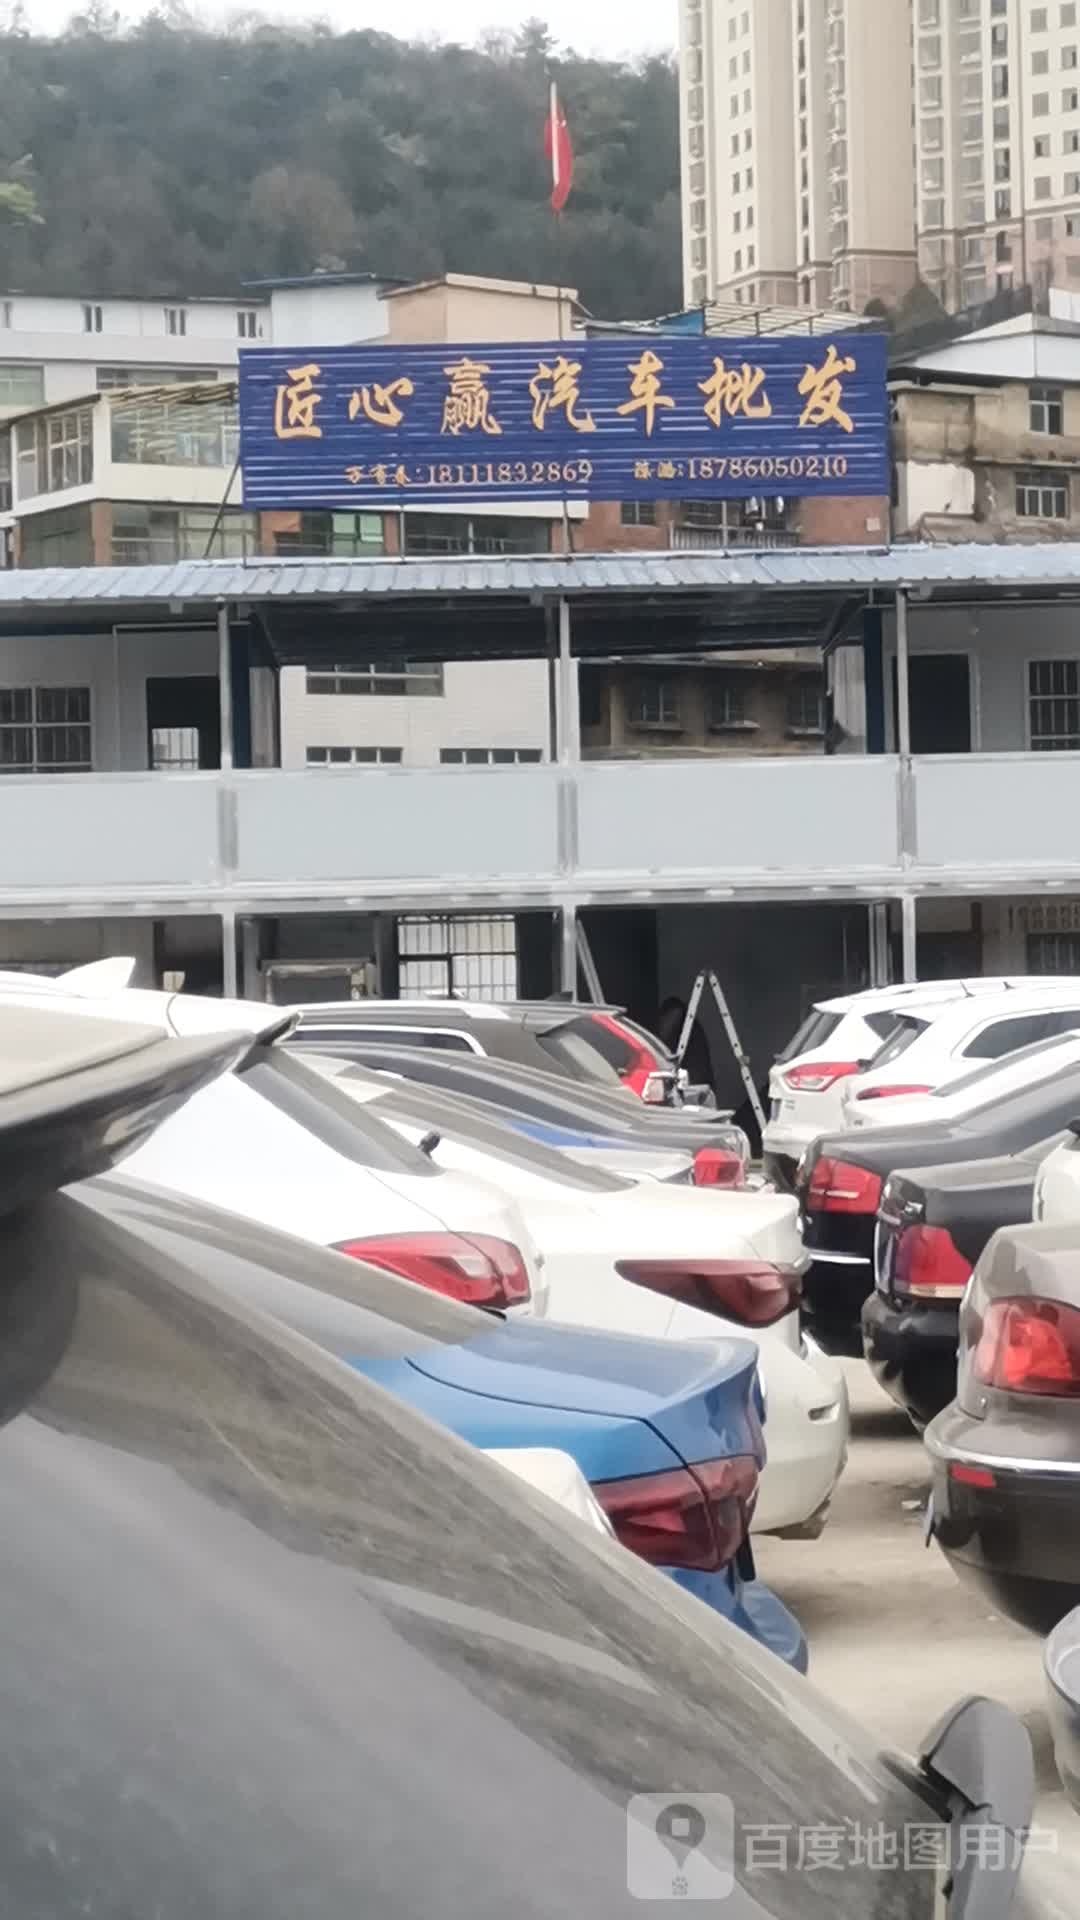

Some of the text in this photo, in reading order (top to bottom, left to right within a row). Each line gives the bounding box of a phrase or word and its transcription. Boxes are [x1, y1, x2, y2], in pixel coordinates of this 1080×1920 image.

[274, 345, 857, 438] 匠心赢汽车批发
